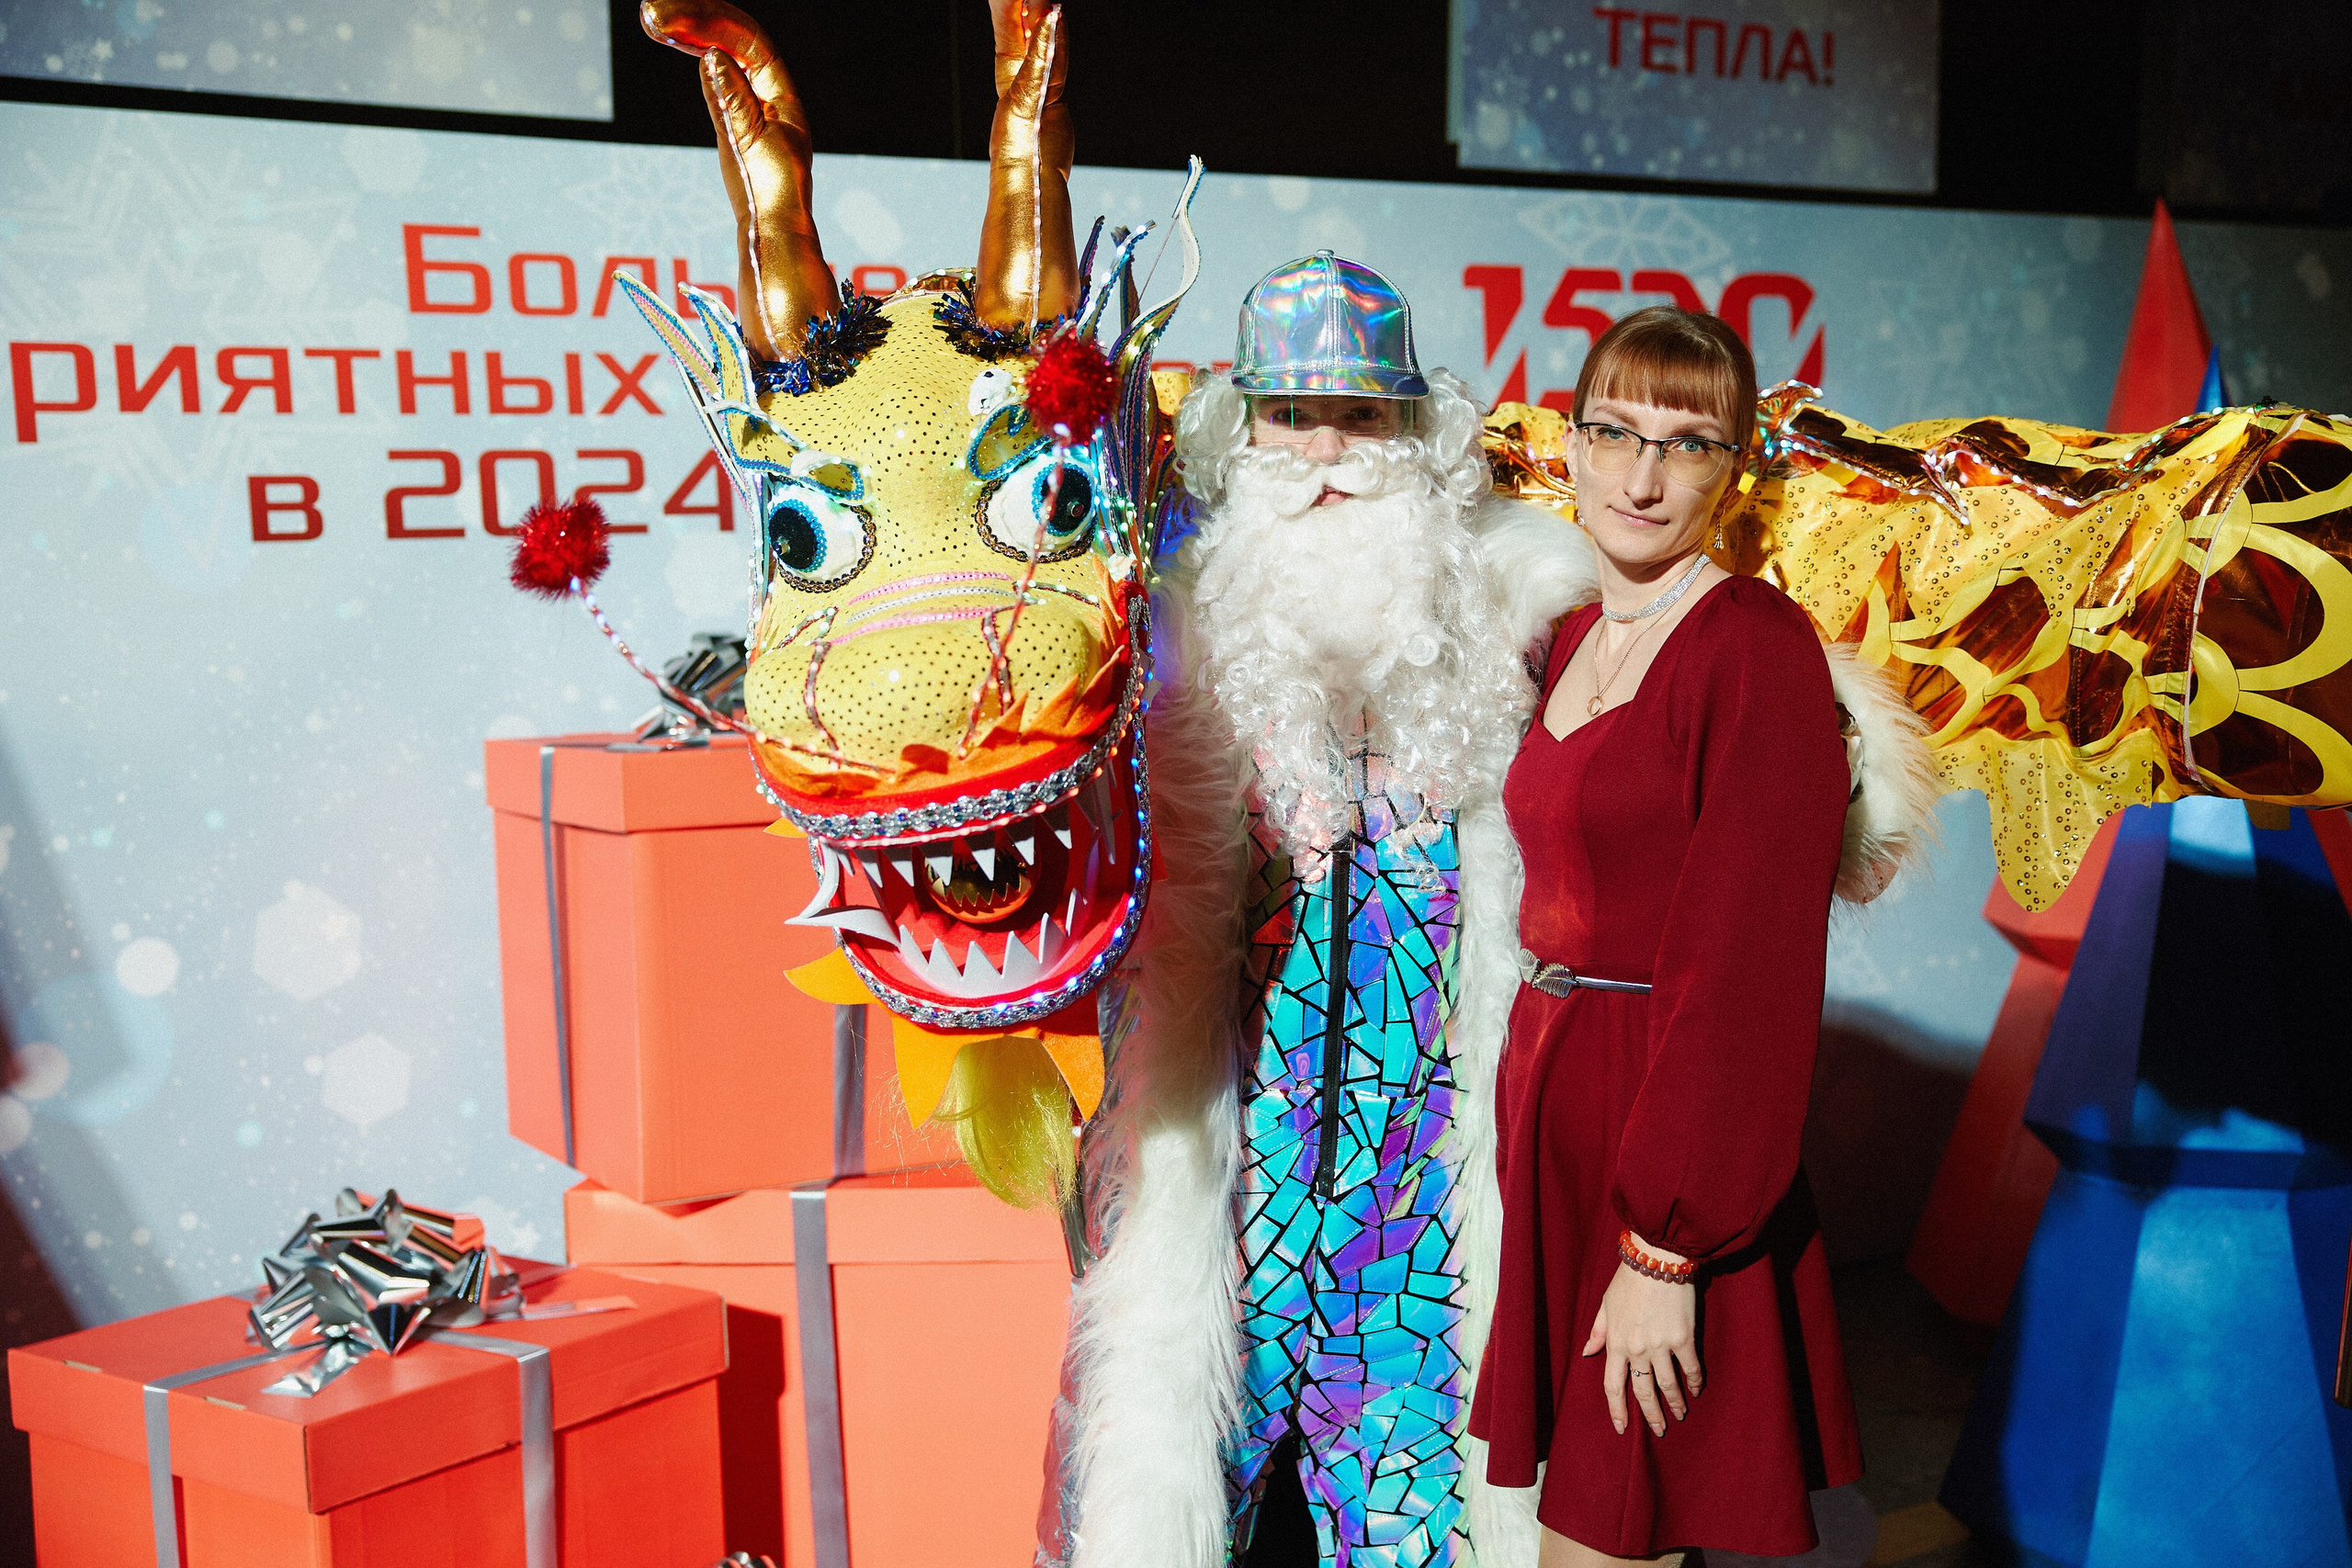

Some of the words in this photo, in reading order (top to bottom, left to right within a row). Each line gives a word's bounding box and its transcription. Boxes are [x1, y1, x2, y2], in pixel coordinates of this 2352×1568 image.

[1592, 6, 1835, 85] ТЕПЛА!
[401, 223, 910, 321] Болье
[247, 475, 323, 542] в
[385, 449, 736, 539] 2024
